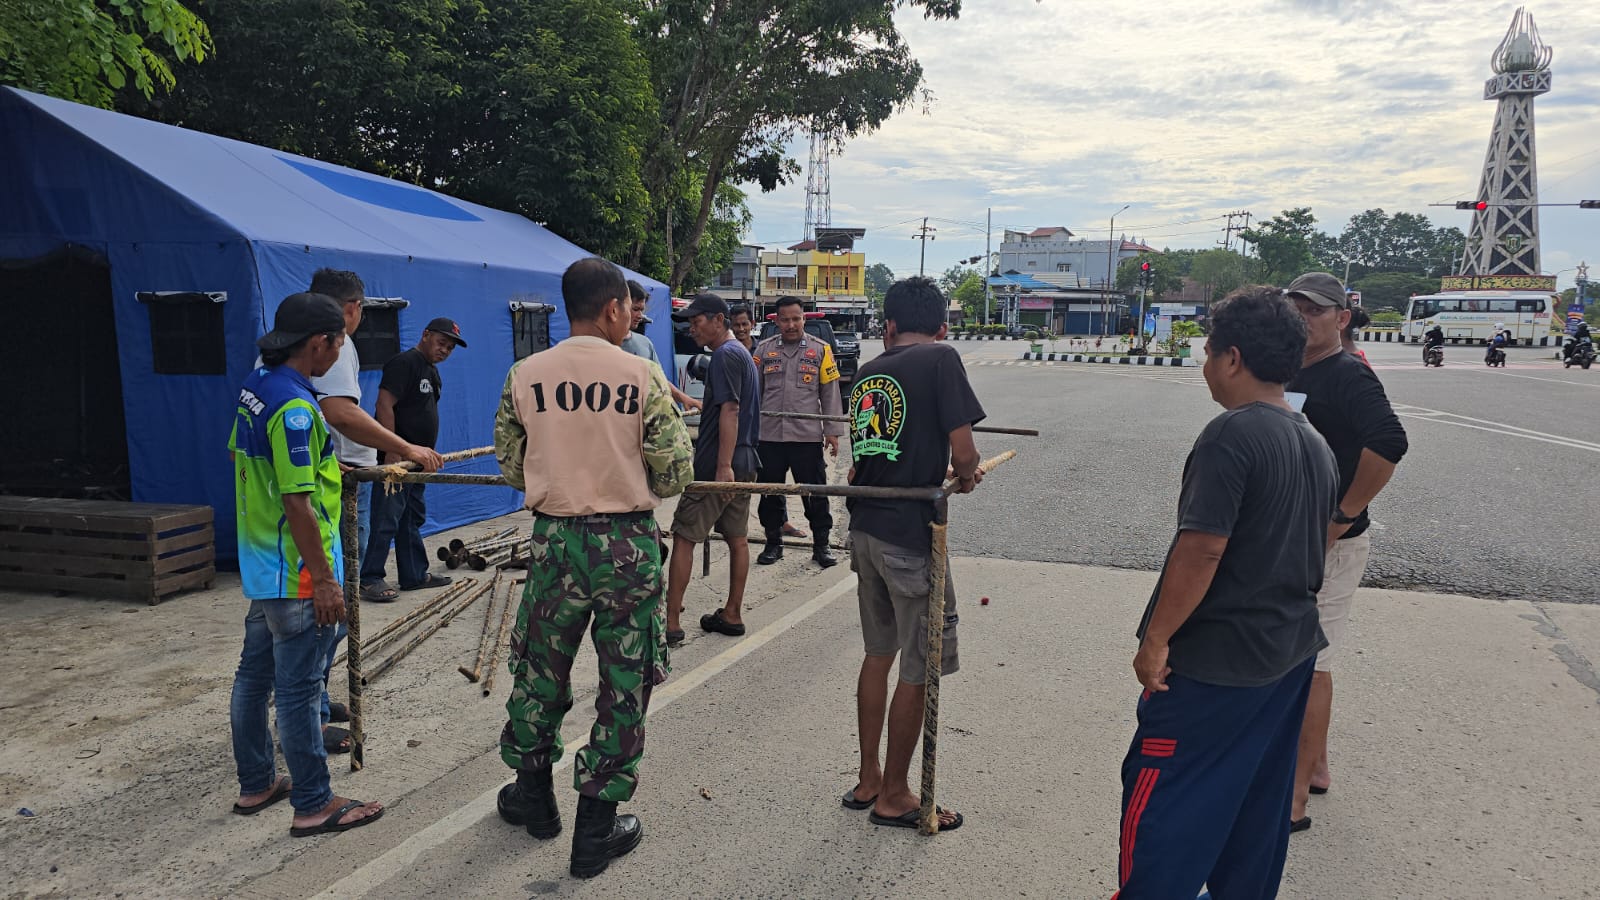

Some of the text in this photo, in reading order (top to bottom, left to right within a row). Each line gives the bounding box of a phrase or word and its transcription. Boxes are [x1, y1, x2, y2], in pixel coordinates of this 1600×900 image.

[530, 381, 639, 415] 1008
[861, 379, 884, 393] KLC
[884, 380, 903, 437] TABALONG
